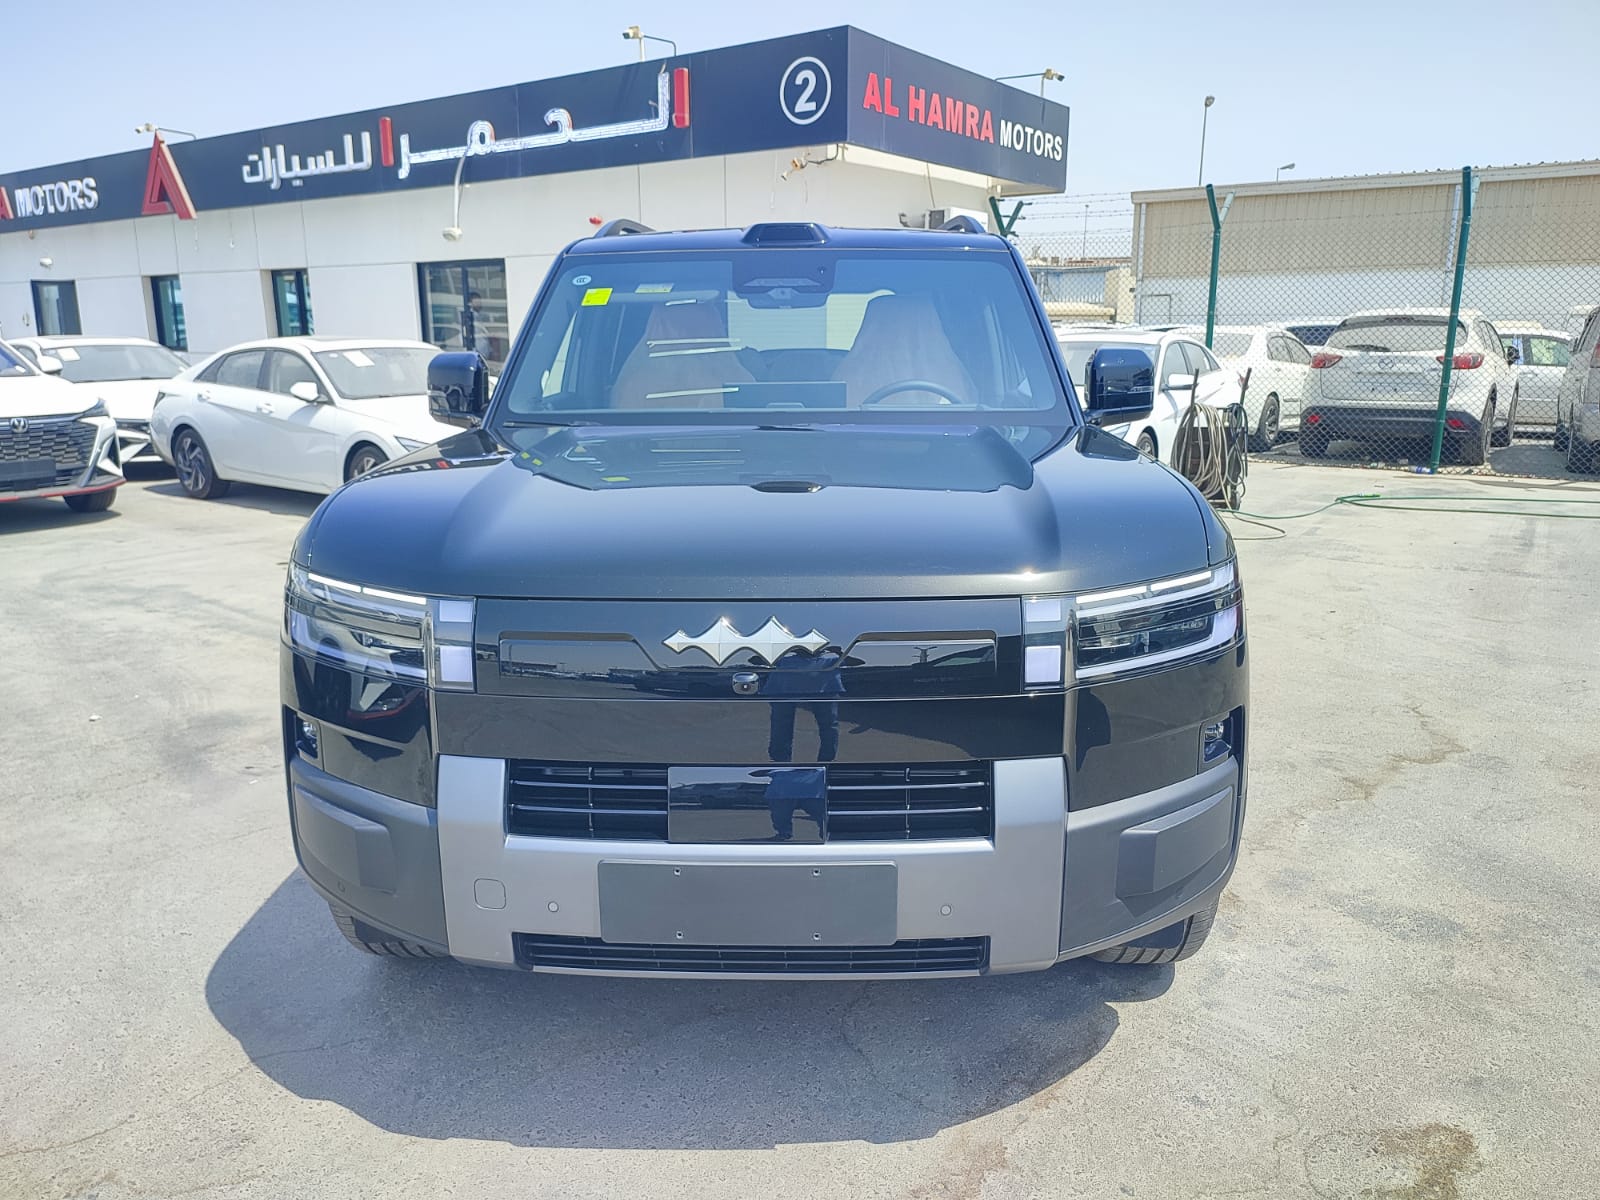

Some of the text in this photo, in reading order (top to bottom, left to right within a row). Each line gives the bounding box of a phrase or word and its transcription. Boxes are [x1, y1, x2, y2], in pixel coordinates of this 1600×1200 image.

[794, 69, 817, 113] 2
[863, 72, 1063, 161] AL HAMRA MOTORS
[242, 131, 372, 190] للسيارات
[15, 177, 98, 217] MOTORS
